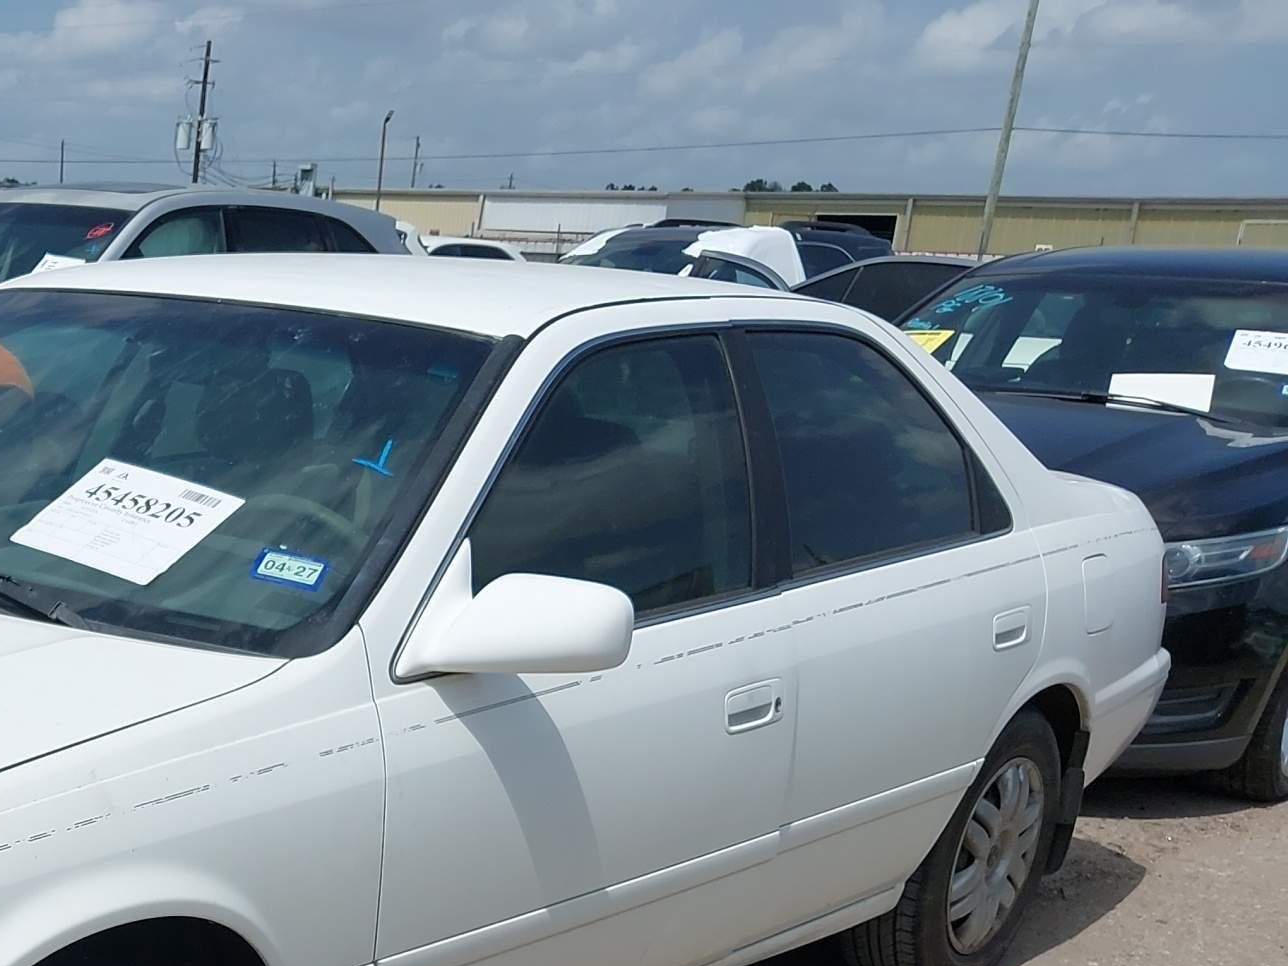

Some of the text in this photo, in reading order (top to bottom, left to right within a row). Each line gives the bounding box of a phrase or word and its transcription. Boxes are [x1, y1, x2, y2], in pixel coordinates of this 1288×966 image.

[85, 483, 204, 528] 45458205
[264, 559, 319, 578] 04 27
